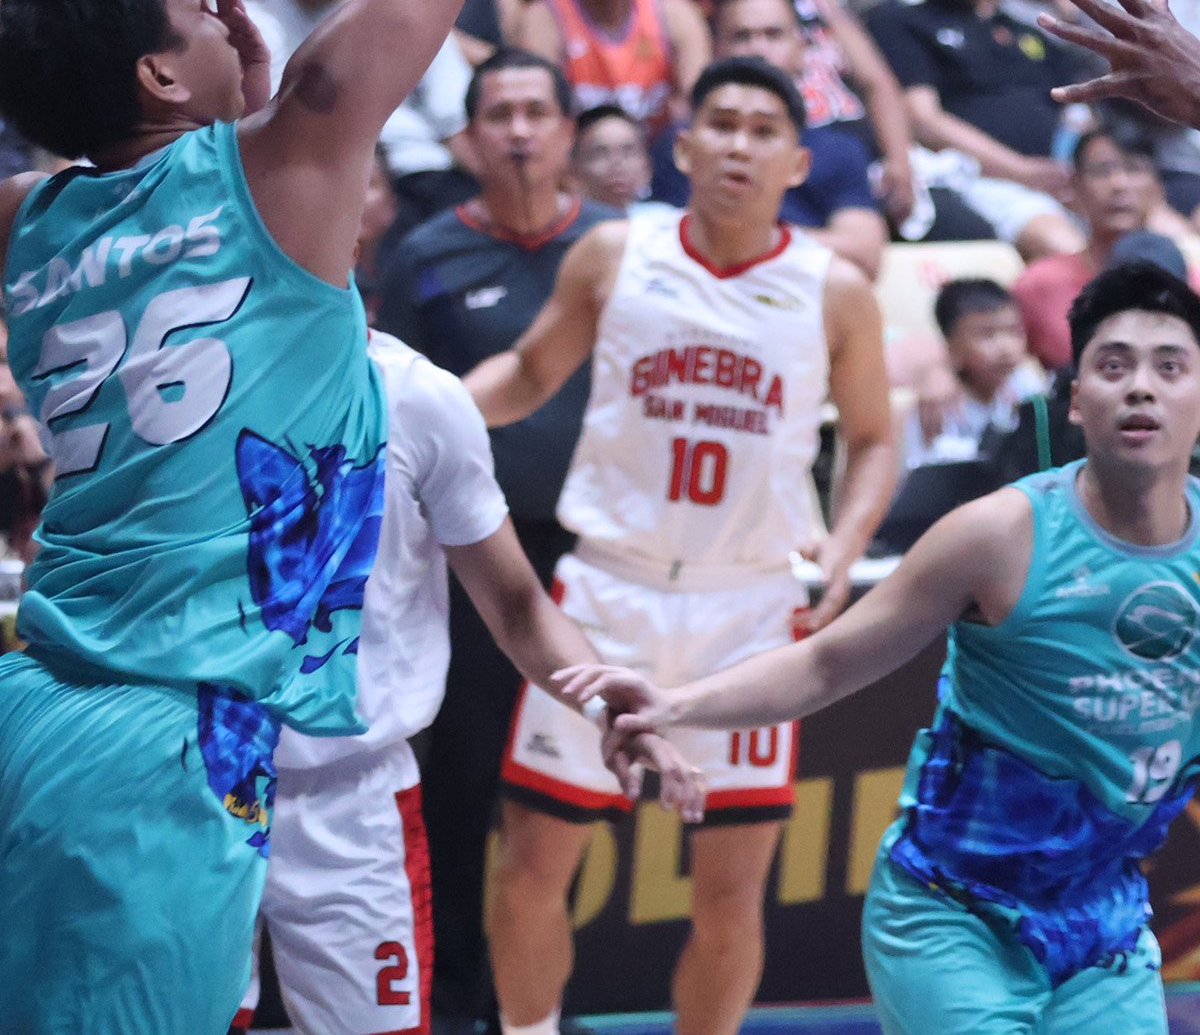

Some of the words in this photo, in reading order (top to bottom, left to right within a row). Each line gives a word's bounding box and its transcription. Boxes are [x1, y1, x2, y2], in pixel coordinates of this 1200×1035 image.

[6, 205, 225, 317] SANTOS
[32, 276, 254, 480] 26
[668, 437, 729, 506] 10
[375, 941, 409, 1005] 2
